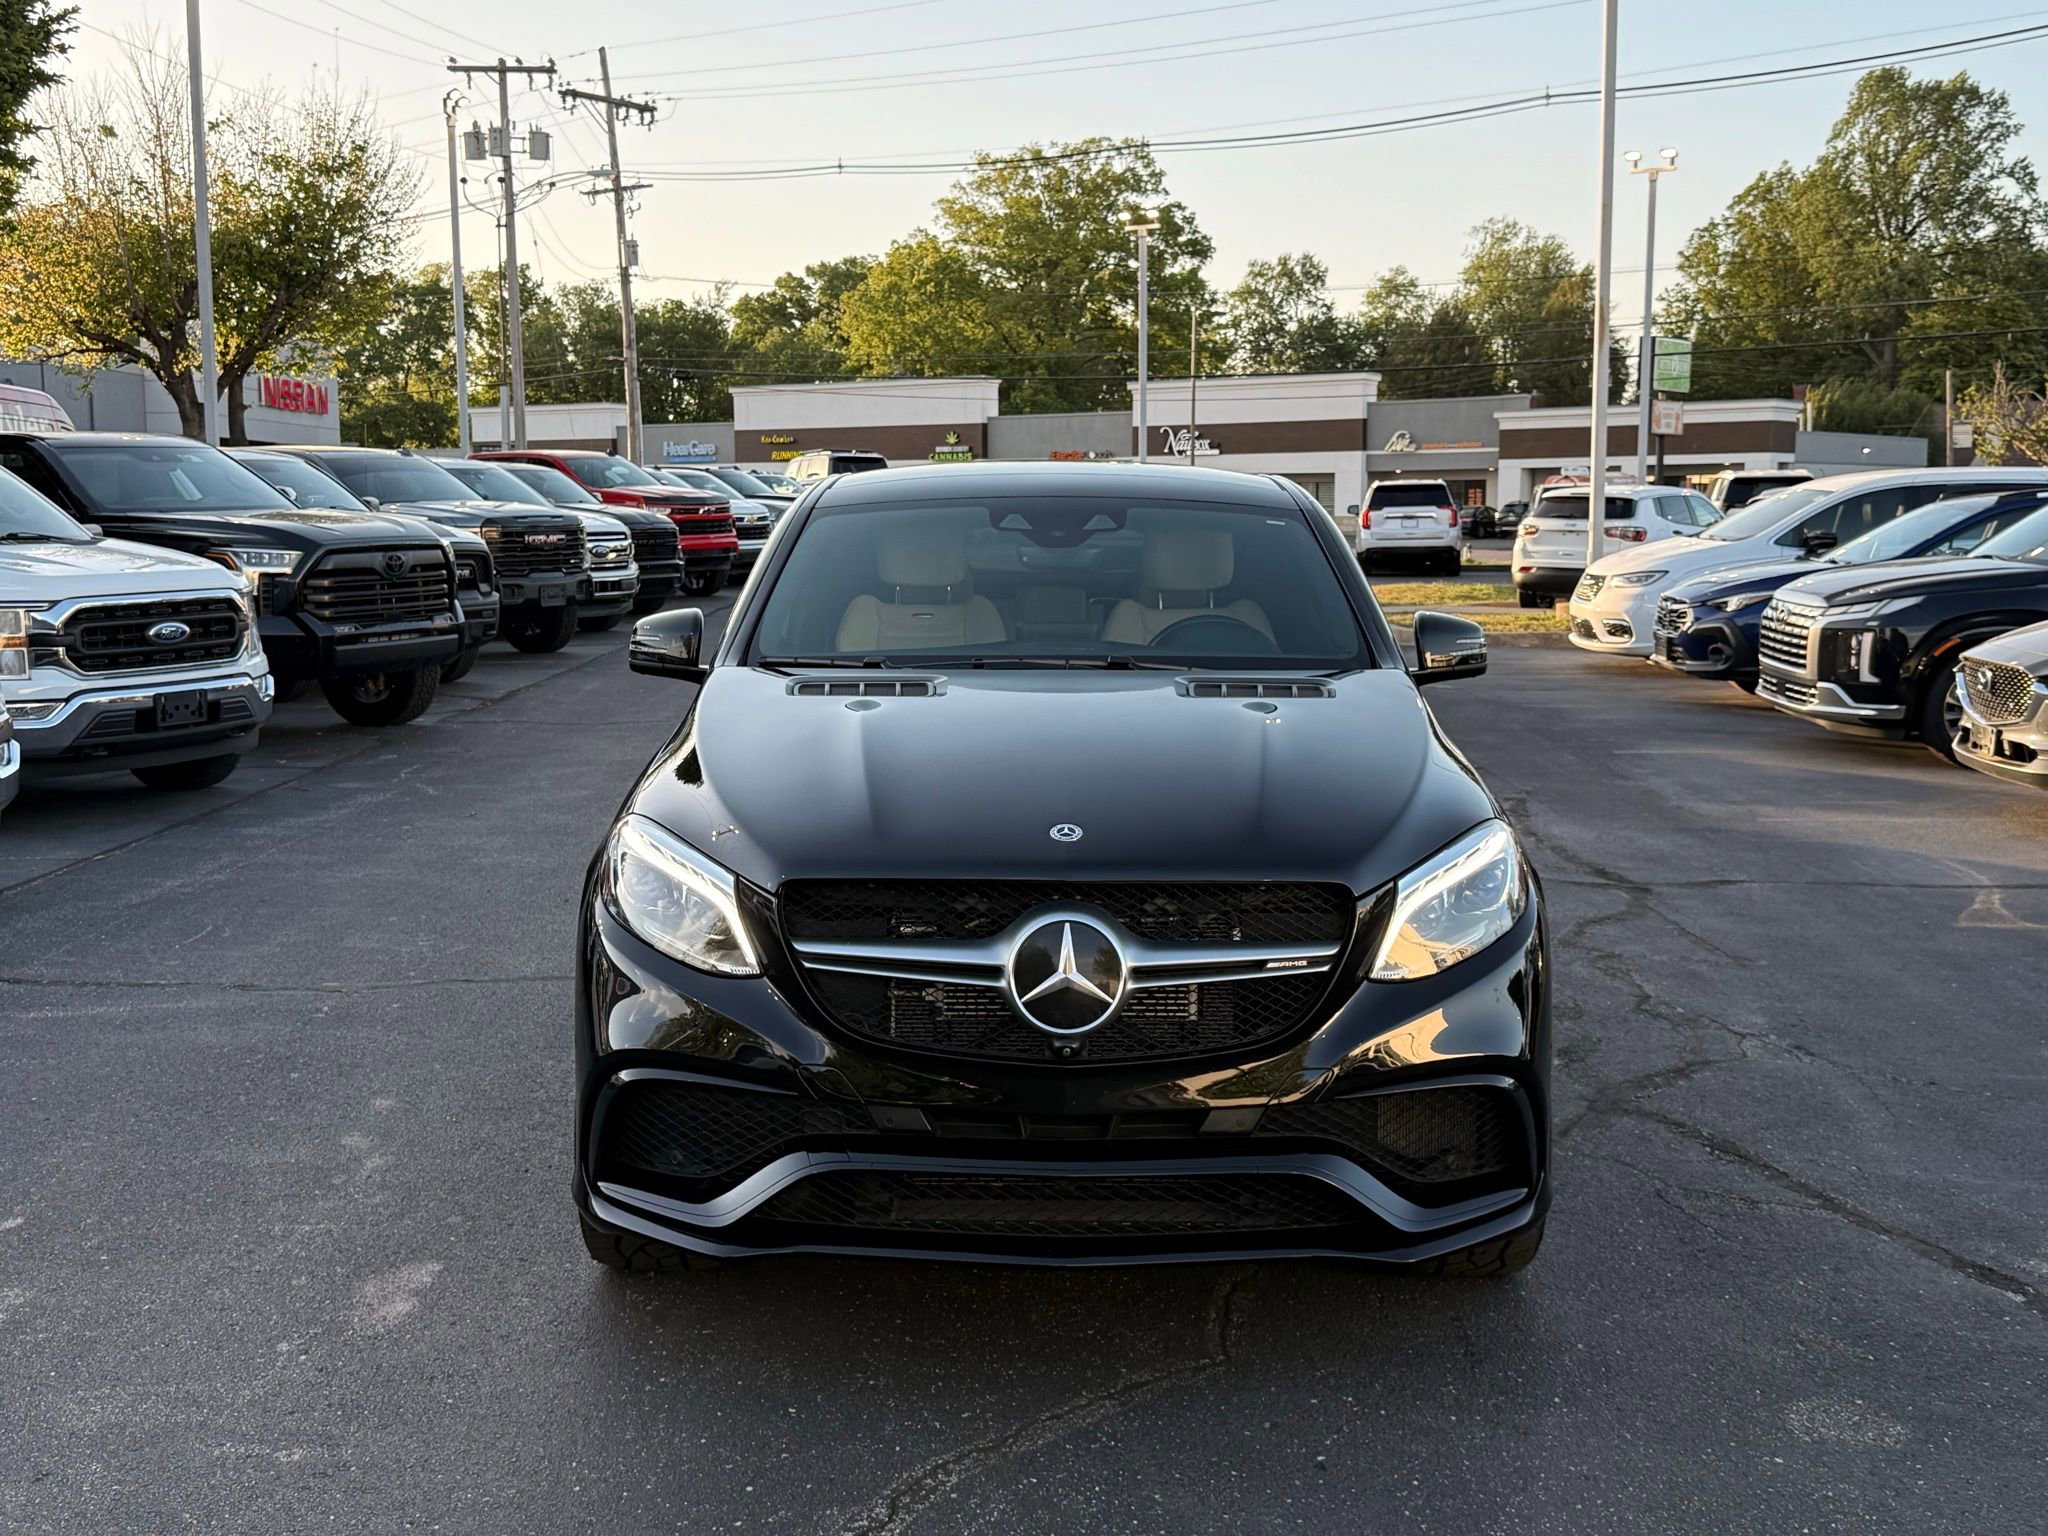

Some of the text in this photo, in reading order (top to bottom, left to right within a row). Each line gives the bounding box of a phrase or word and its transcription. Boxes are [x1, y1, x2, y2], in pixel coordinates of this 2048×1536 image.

[261, 375, 329, 415] NISSAN
[663, 441, 716, 456] HearCare
[771, 451, 802, 461] RUNNIN
[928, 452, 973, 462] CANNABIS
[1279, 960, 1308, 968] AMG
